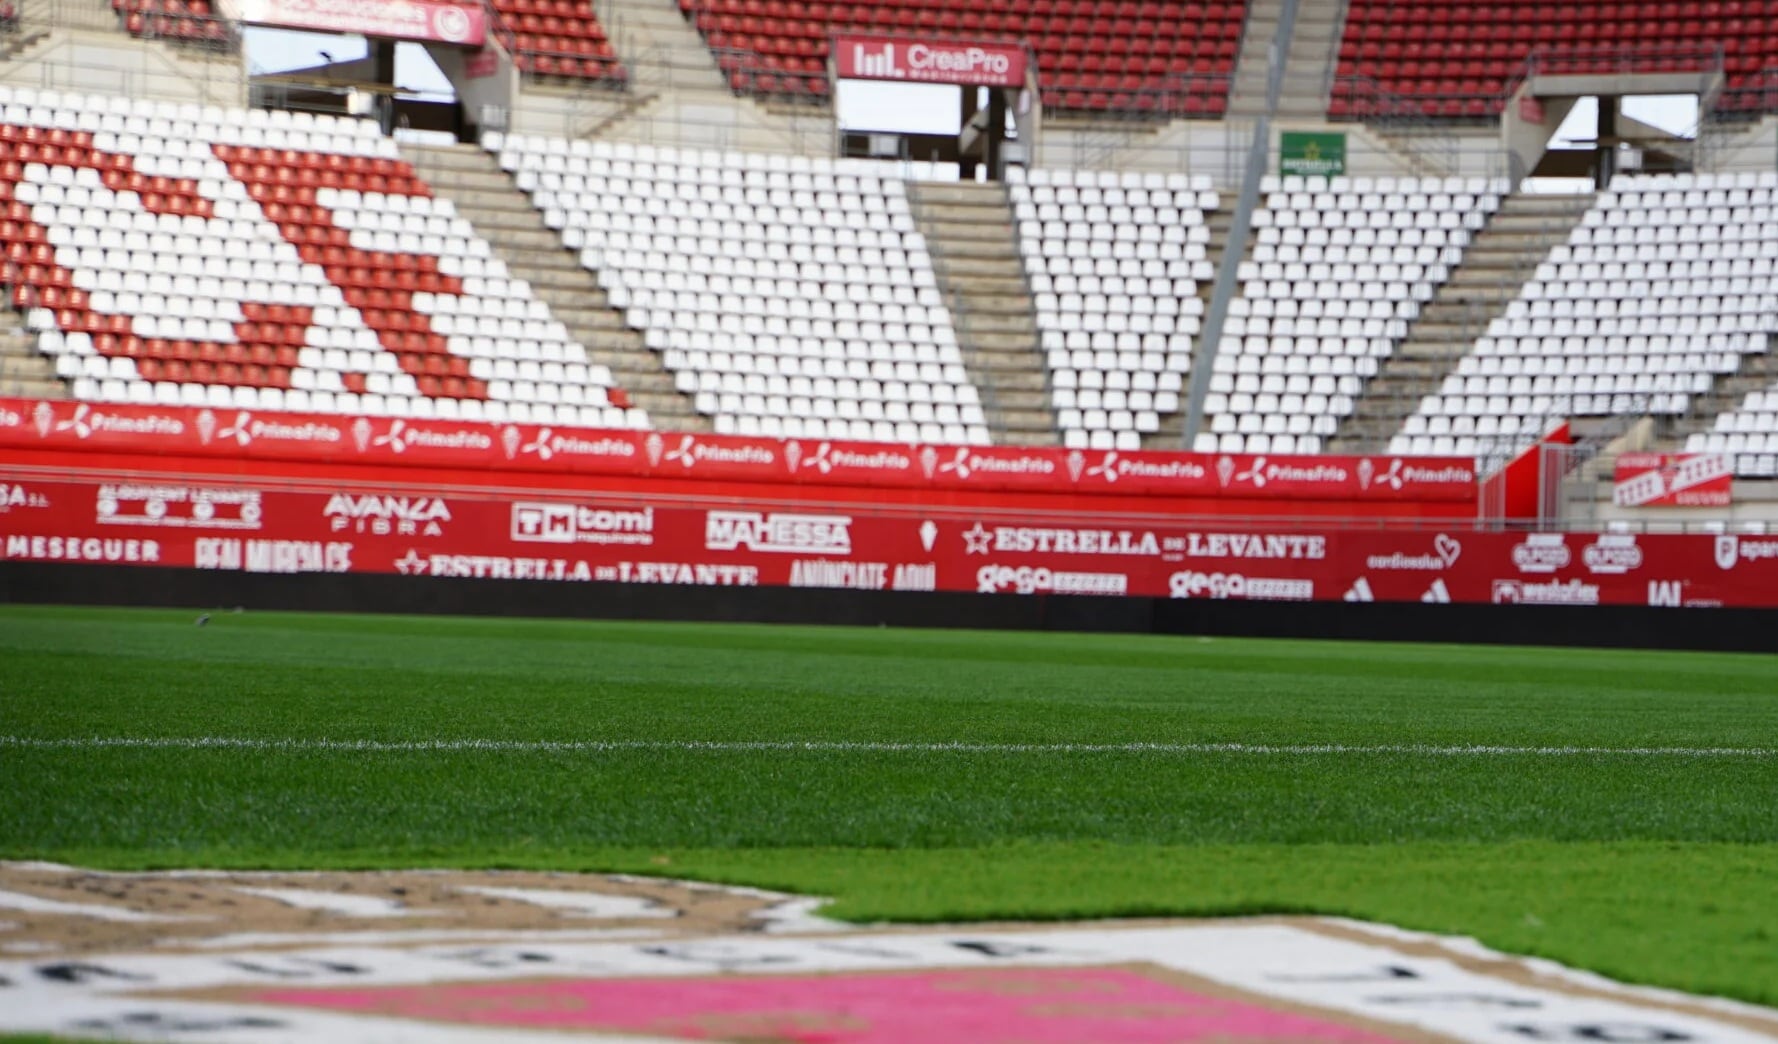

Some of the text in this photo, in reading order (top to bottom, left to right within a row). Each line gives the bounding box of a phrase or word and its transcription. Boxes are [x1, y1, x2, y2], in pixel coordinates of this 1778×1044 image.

[907, 44, 1009, 74] CreaPro
[92, 413, 184, 435] PrimaFrio
[252, 420, 341, 442] PrimaFrio
[405, 428, 492, 450] PrimaFrio
[552, 435, 635, 457] PrimaFrio
[696, 442, 774, 464] PrimaFrio
[831, 450, 910, 470] PrimaFrio
[970, 454, 1055, 475] PrimaFrio
[1119, 459, 1205, 479] PrimaFrio
[1266, 465, 1347, 483] PrimaFrio
[1403, 466, 1473, 483] PrimaFrio
[322, 494, 452, 521] AVANZA
[577, 506, 654, 531] tomi
[331, 517, 443, 536] FIBRA
[706, 511, 852, 554] MAHESSA
[7, 535, 159, 561] MESEGUER
[994, 527, 1160, 555] ESTRELLA
[1187, 533, 1326, 559] LEVANTE
[429, 554, 592, 582] ESTRELLA
[618, 561, 758, 585] LEVANTE
